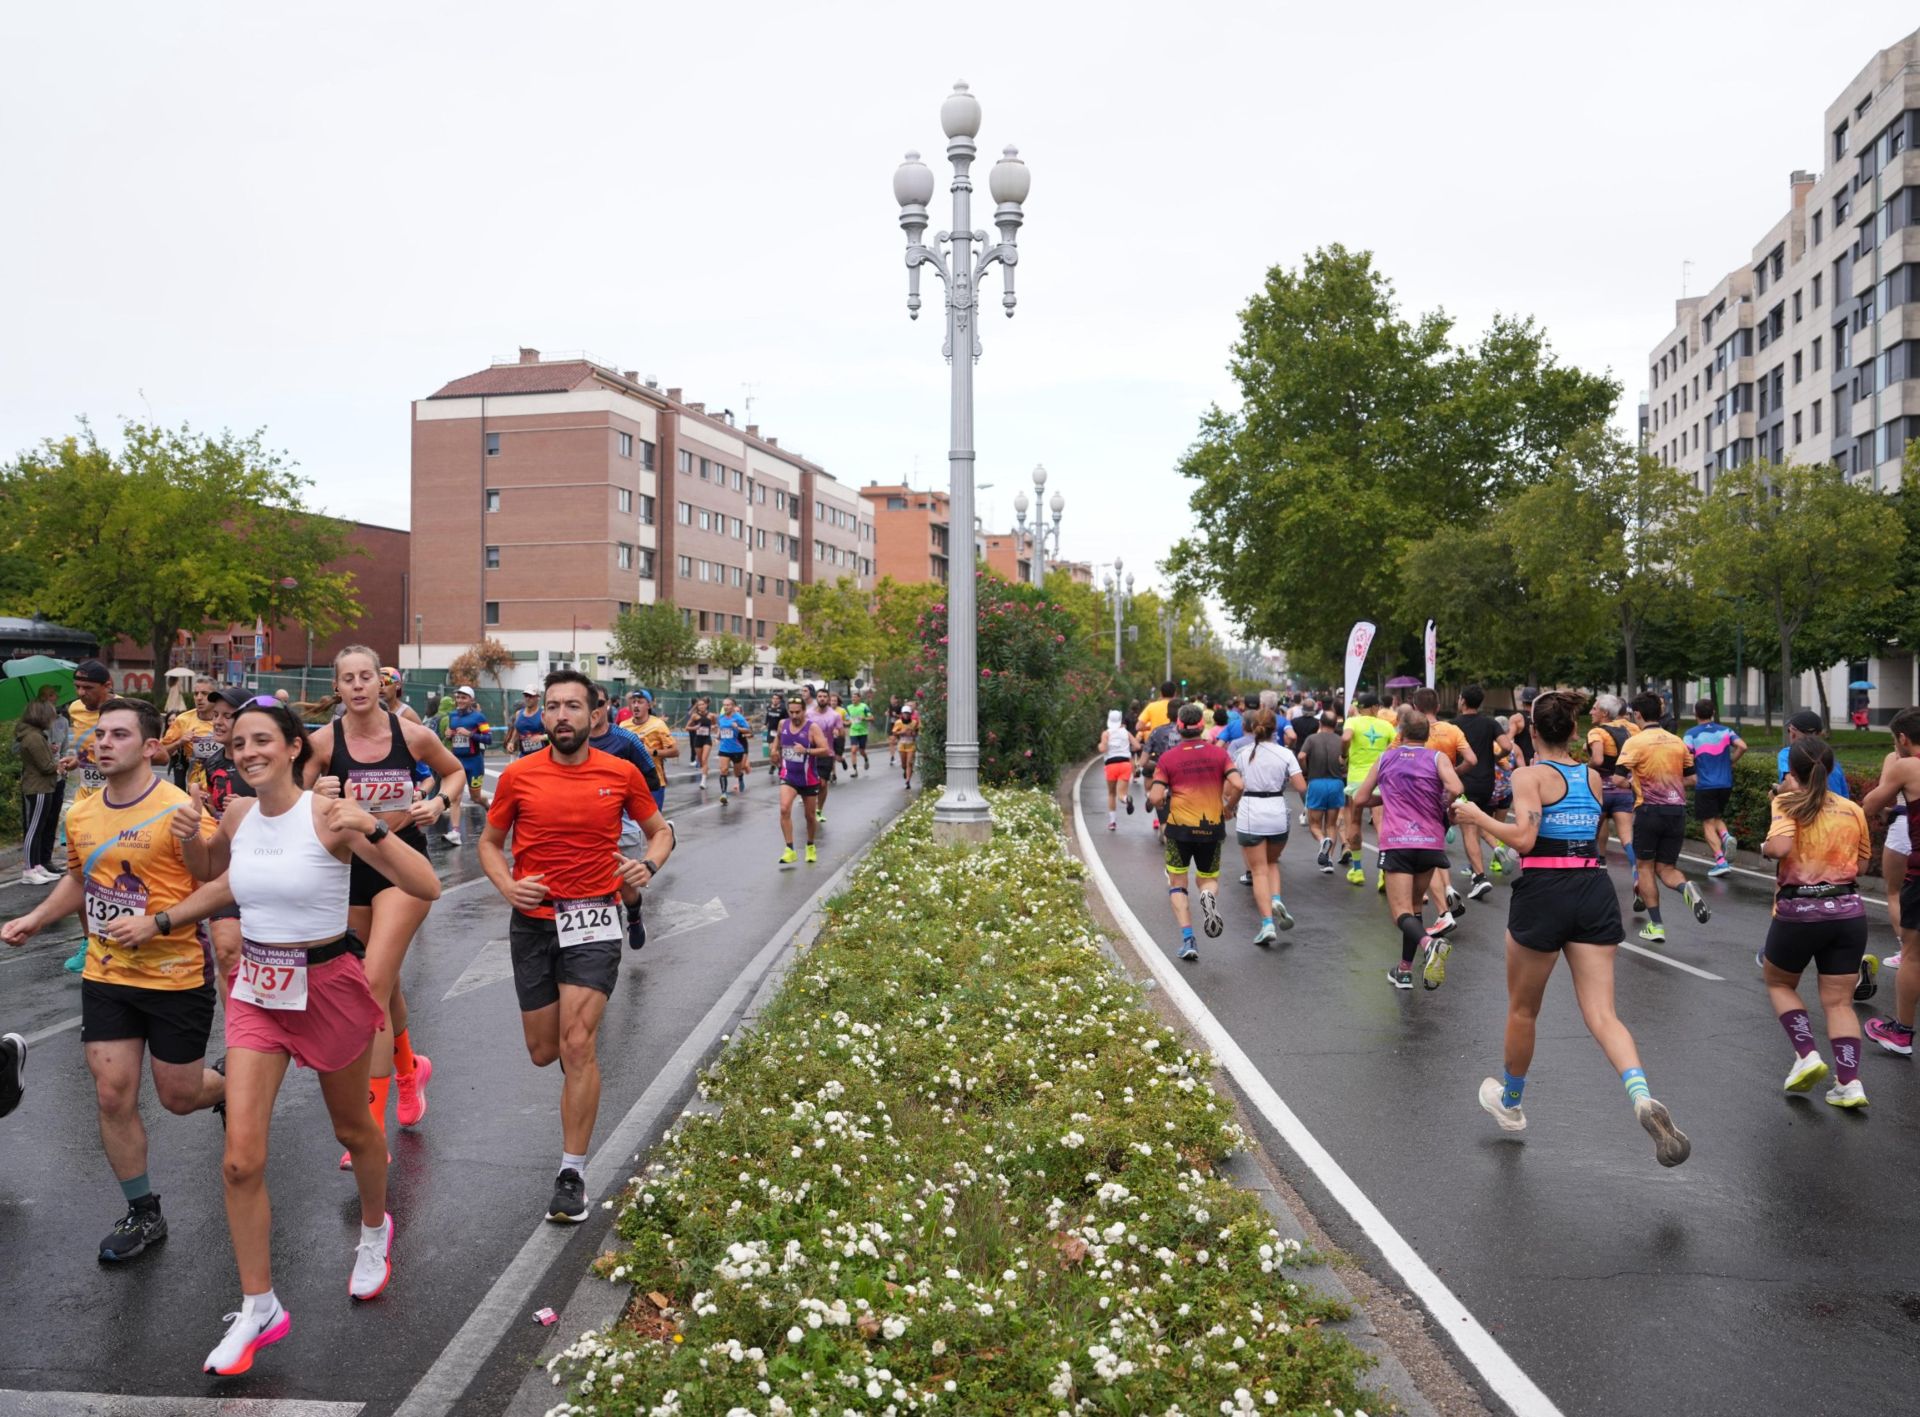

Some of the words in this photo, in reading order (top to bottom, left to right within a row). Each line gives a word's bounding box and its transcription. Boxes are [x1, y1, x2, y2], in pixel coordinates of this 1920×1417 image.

[198, 742, 219, 752] 336
[353, 782, 405, 801] 1725
[118, 830, 152, 842] MM25
[117, 841, 151, 849] VALLADOLID
[254, 847, 284, 856] OYSHO
[98, 886, 114, 896] MEDIA
[100, 893, 137, 906] VALLADOLID
[560, 908, 612, 933] 2126
[249, 946, 266, 957] MEDIA
[267, 948, 306, 959] MARATÓN
[252, 955, 295, 966] VALLADOLID
[242, 959, 295, 992] 1737
[1790, 1013, 1815, 1042] Vibes
[1835, 1044, 1859, 1068] Good
